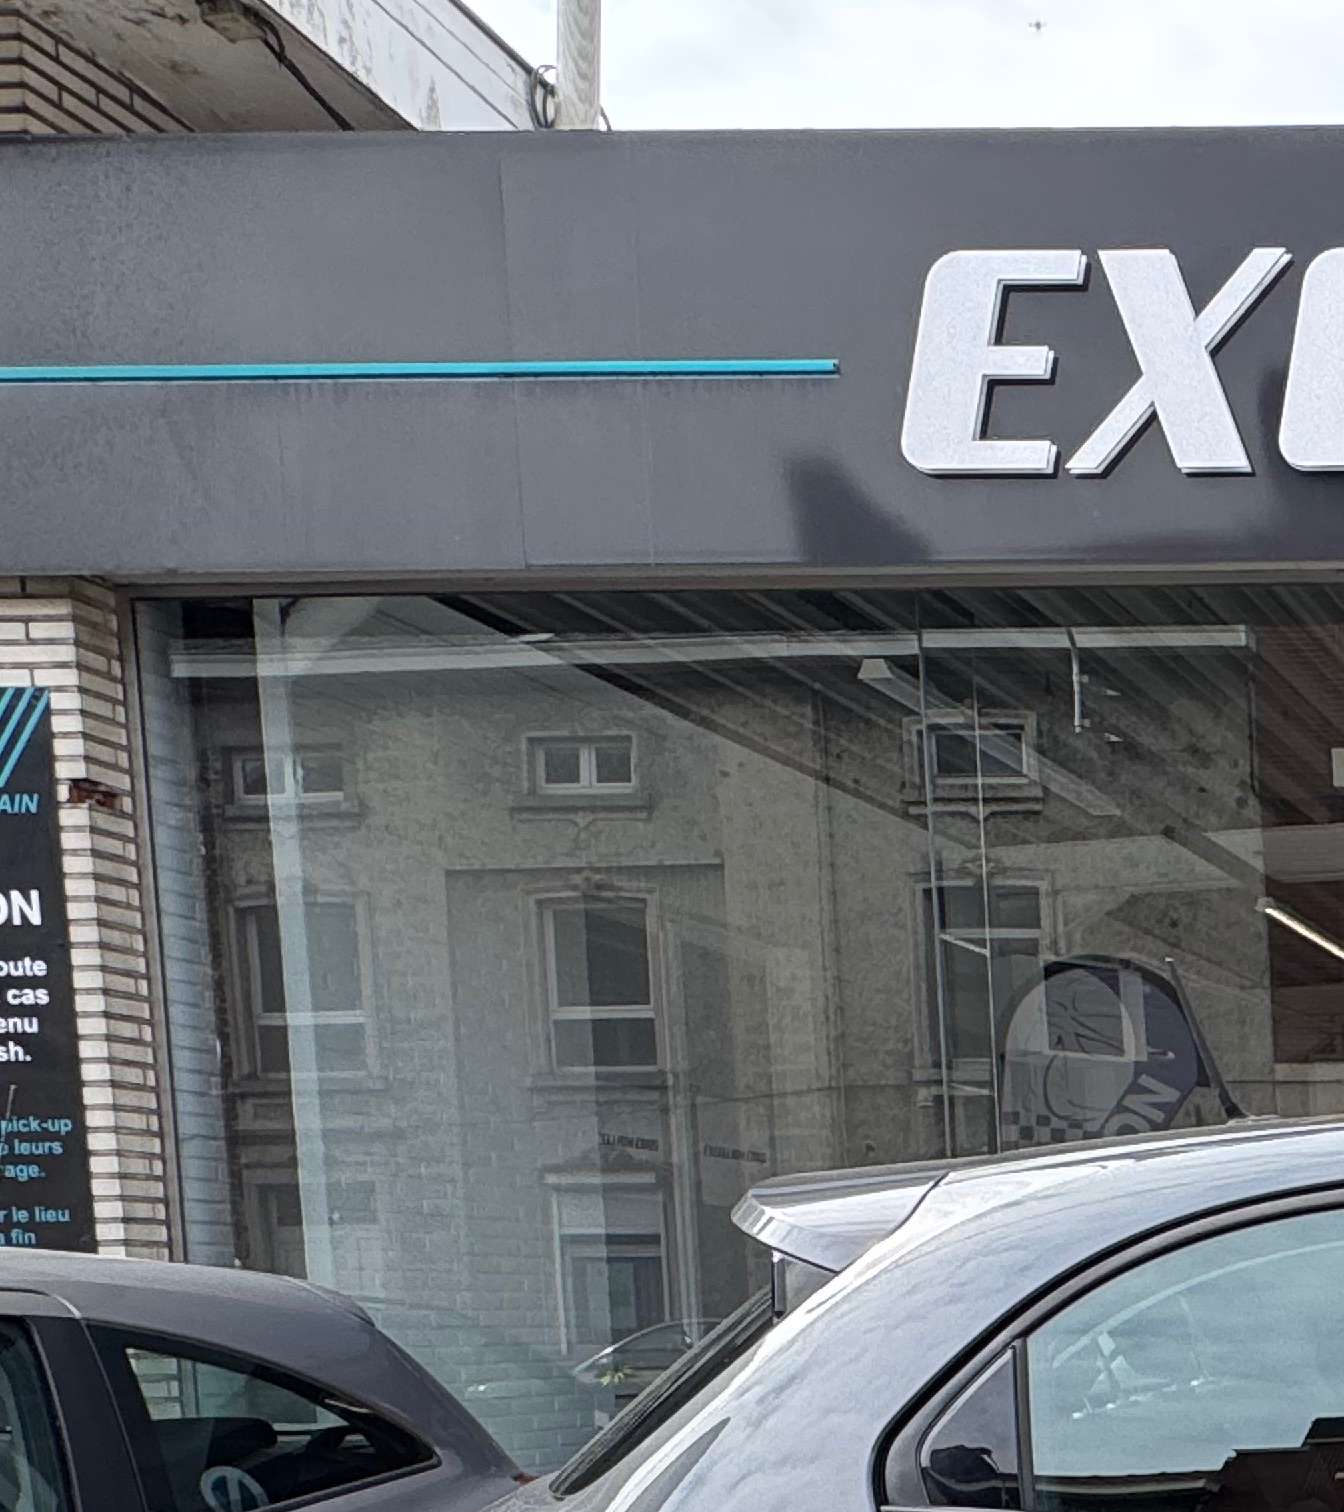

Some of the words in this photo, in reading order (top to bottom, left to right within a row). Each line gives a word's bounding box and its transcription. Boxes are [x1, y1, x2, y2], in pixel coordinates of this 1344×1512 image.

[6, 988, 50, 1005] cas
[14, 1138, 64, 1155] leurs
[12, 1206, 30, 1224] le
[34, 1206, 71, 1223] lieu
